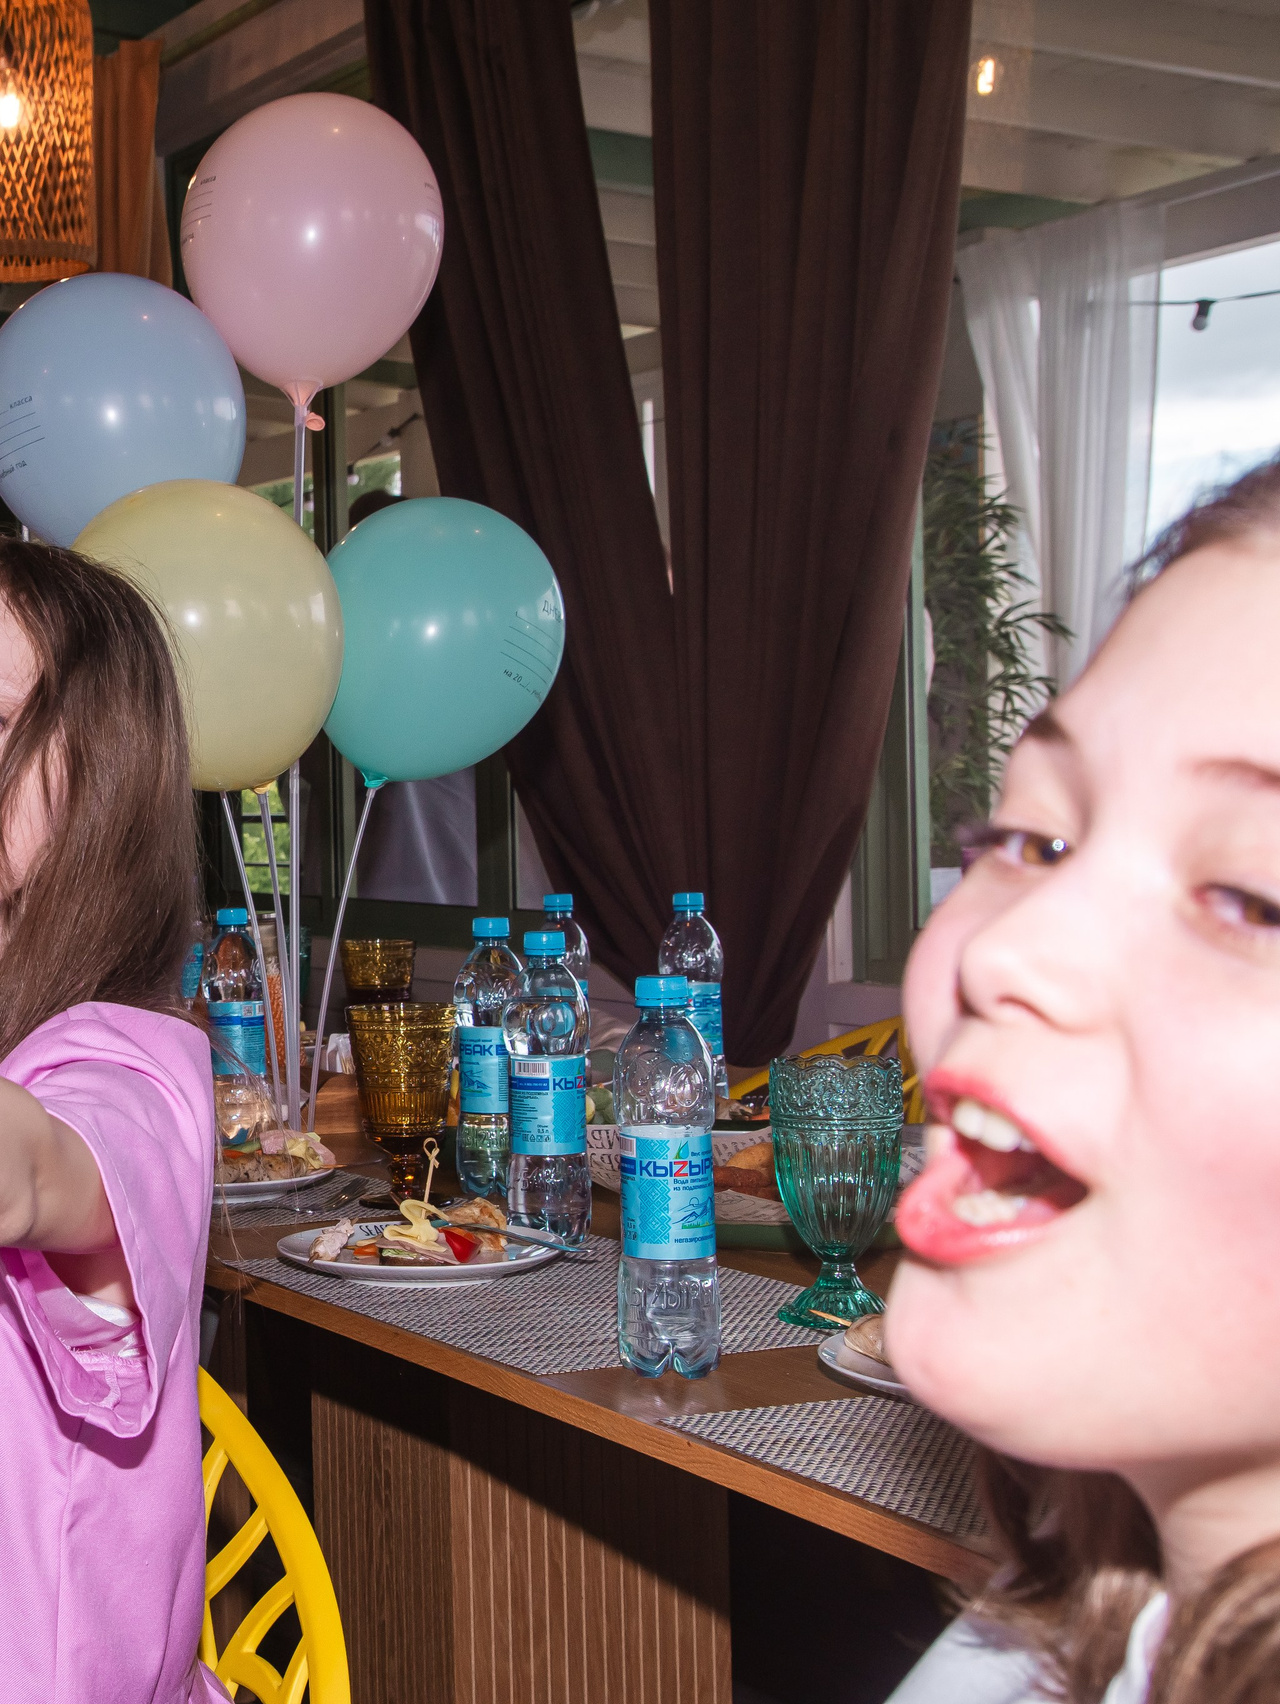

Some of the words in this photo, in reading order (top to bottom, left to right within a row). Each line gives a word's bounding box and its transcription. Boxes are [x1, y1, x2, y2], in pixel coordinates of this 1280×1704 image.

[9, 395, 33, 409] класса
[15, 460, 27, 470] год
[503, 667, 513, 679] на
[640, 1156, 713, 1177] КЫZЫР
